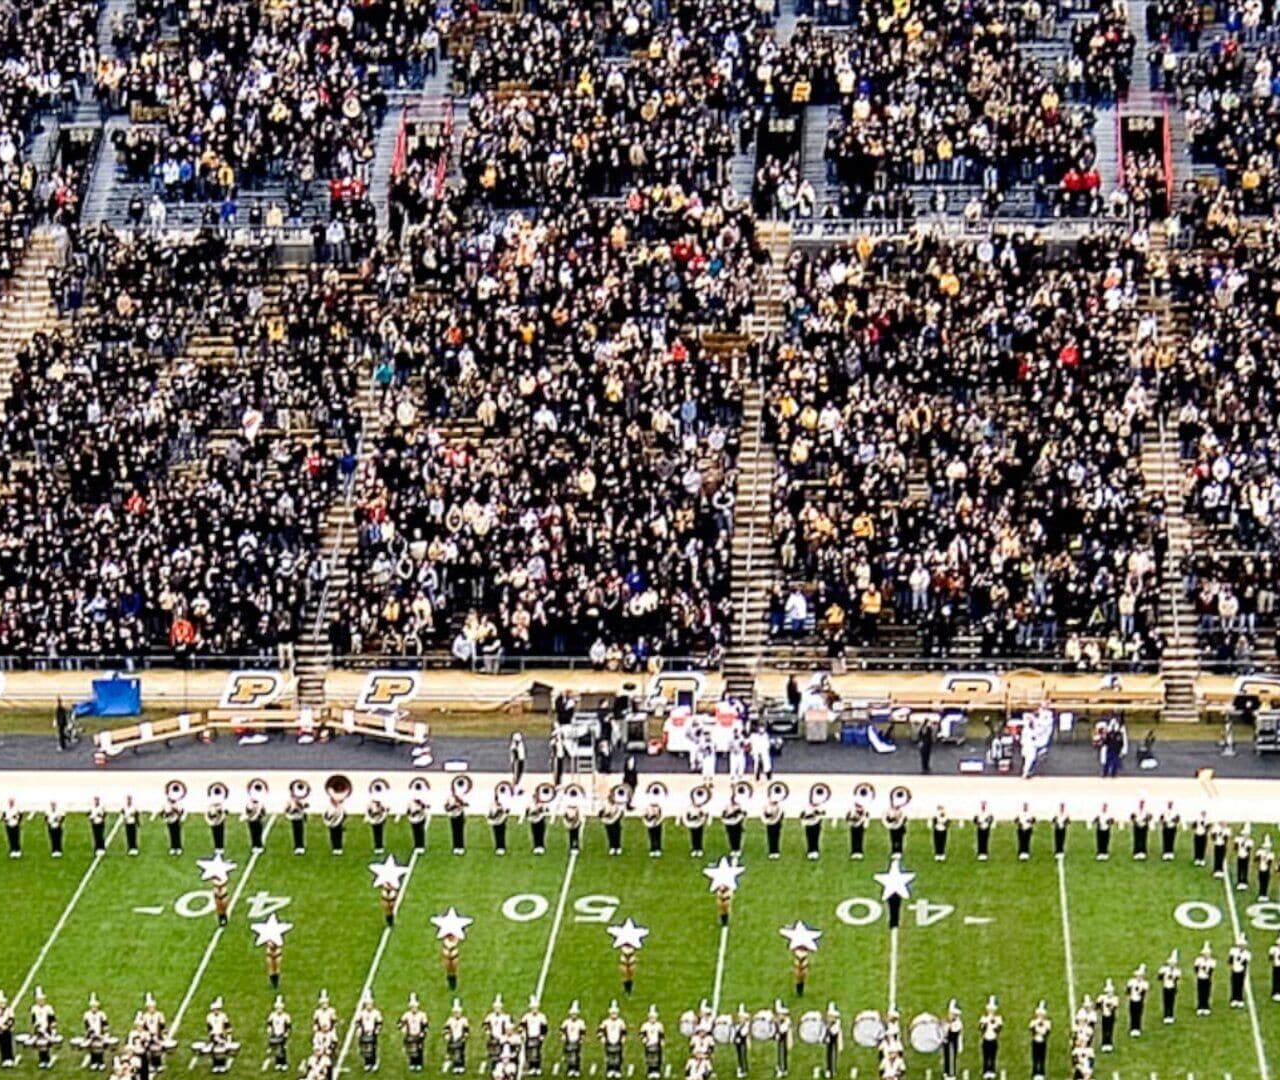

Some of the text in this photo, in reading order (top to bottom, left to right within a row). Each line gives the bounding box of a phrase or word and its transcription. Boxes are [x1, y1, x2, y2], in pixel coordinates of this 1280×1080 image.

[228, 676, 277, 704] P
[365, 676, 414, 704] P
[502, 893, 620, 922] 50
